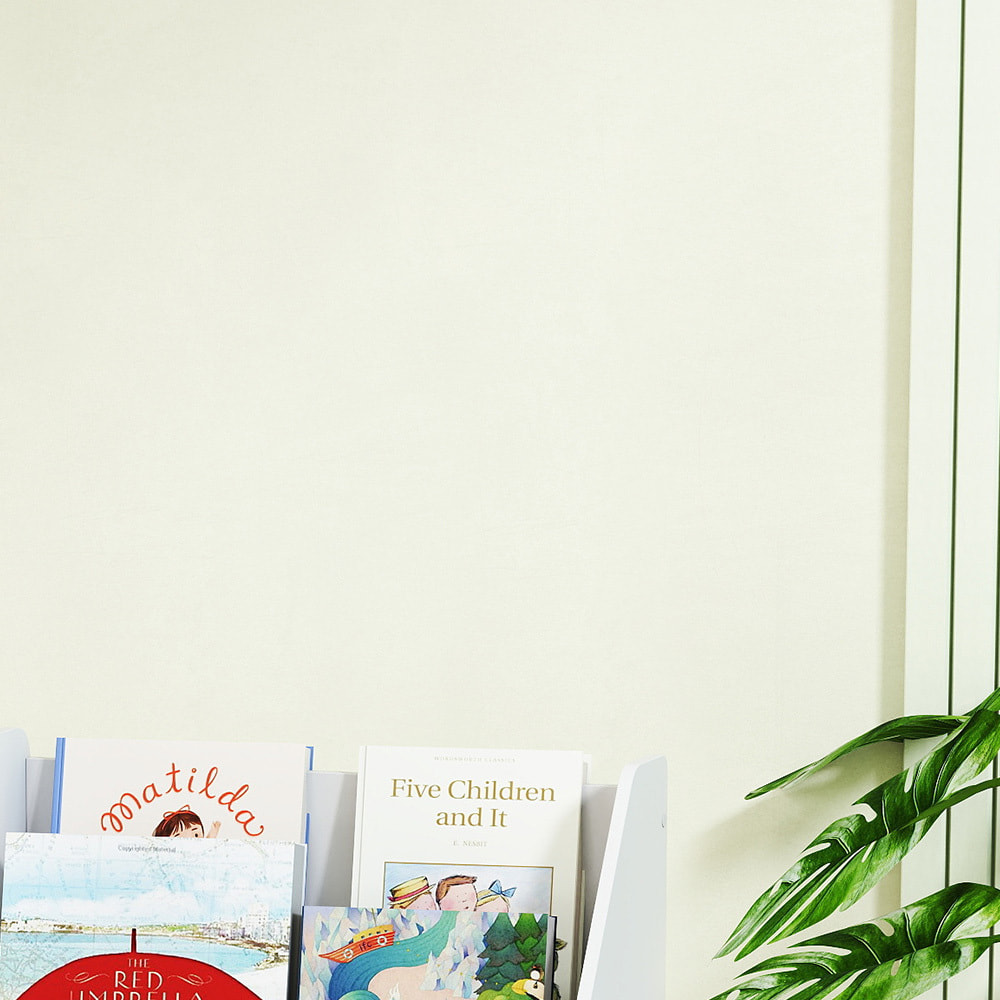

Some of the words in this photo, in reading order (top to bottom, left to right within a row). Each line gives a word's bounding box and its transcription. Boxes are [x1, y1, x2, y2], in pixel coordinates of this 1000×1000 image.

[100, 762, 265, 837] Matilda
[390, 778, 442, 799] Five
[447, 779, 557, 802] Children
[435, 807, 484, 828] and
[490, 808, 509, 828] It
[128, 958, 150, 968] THE
[114, 970, 164, 990] RED
